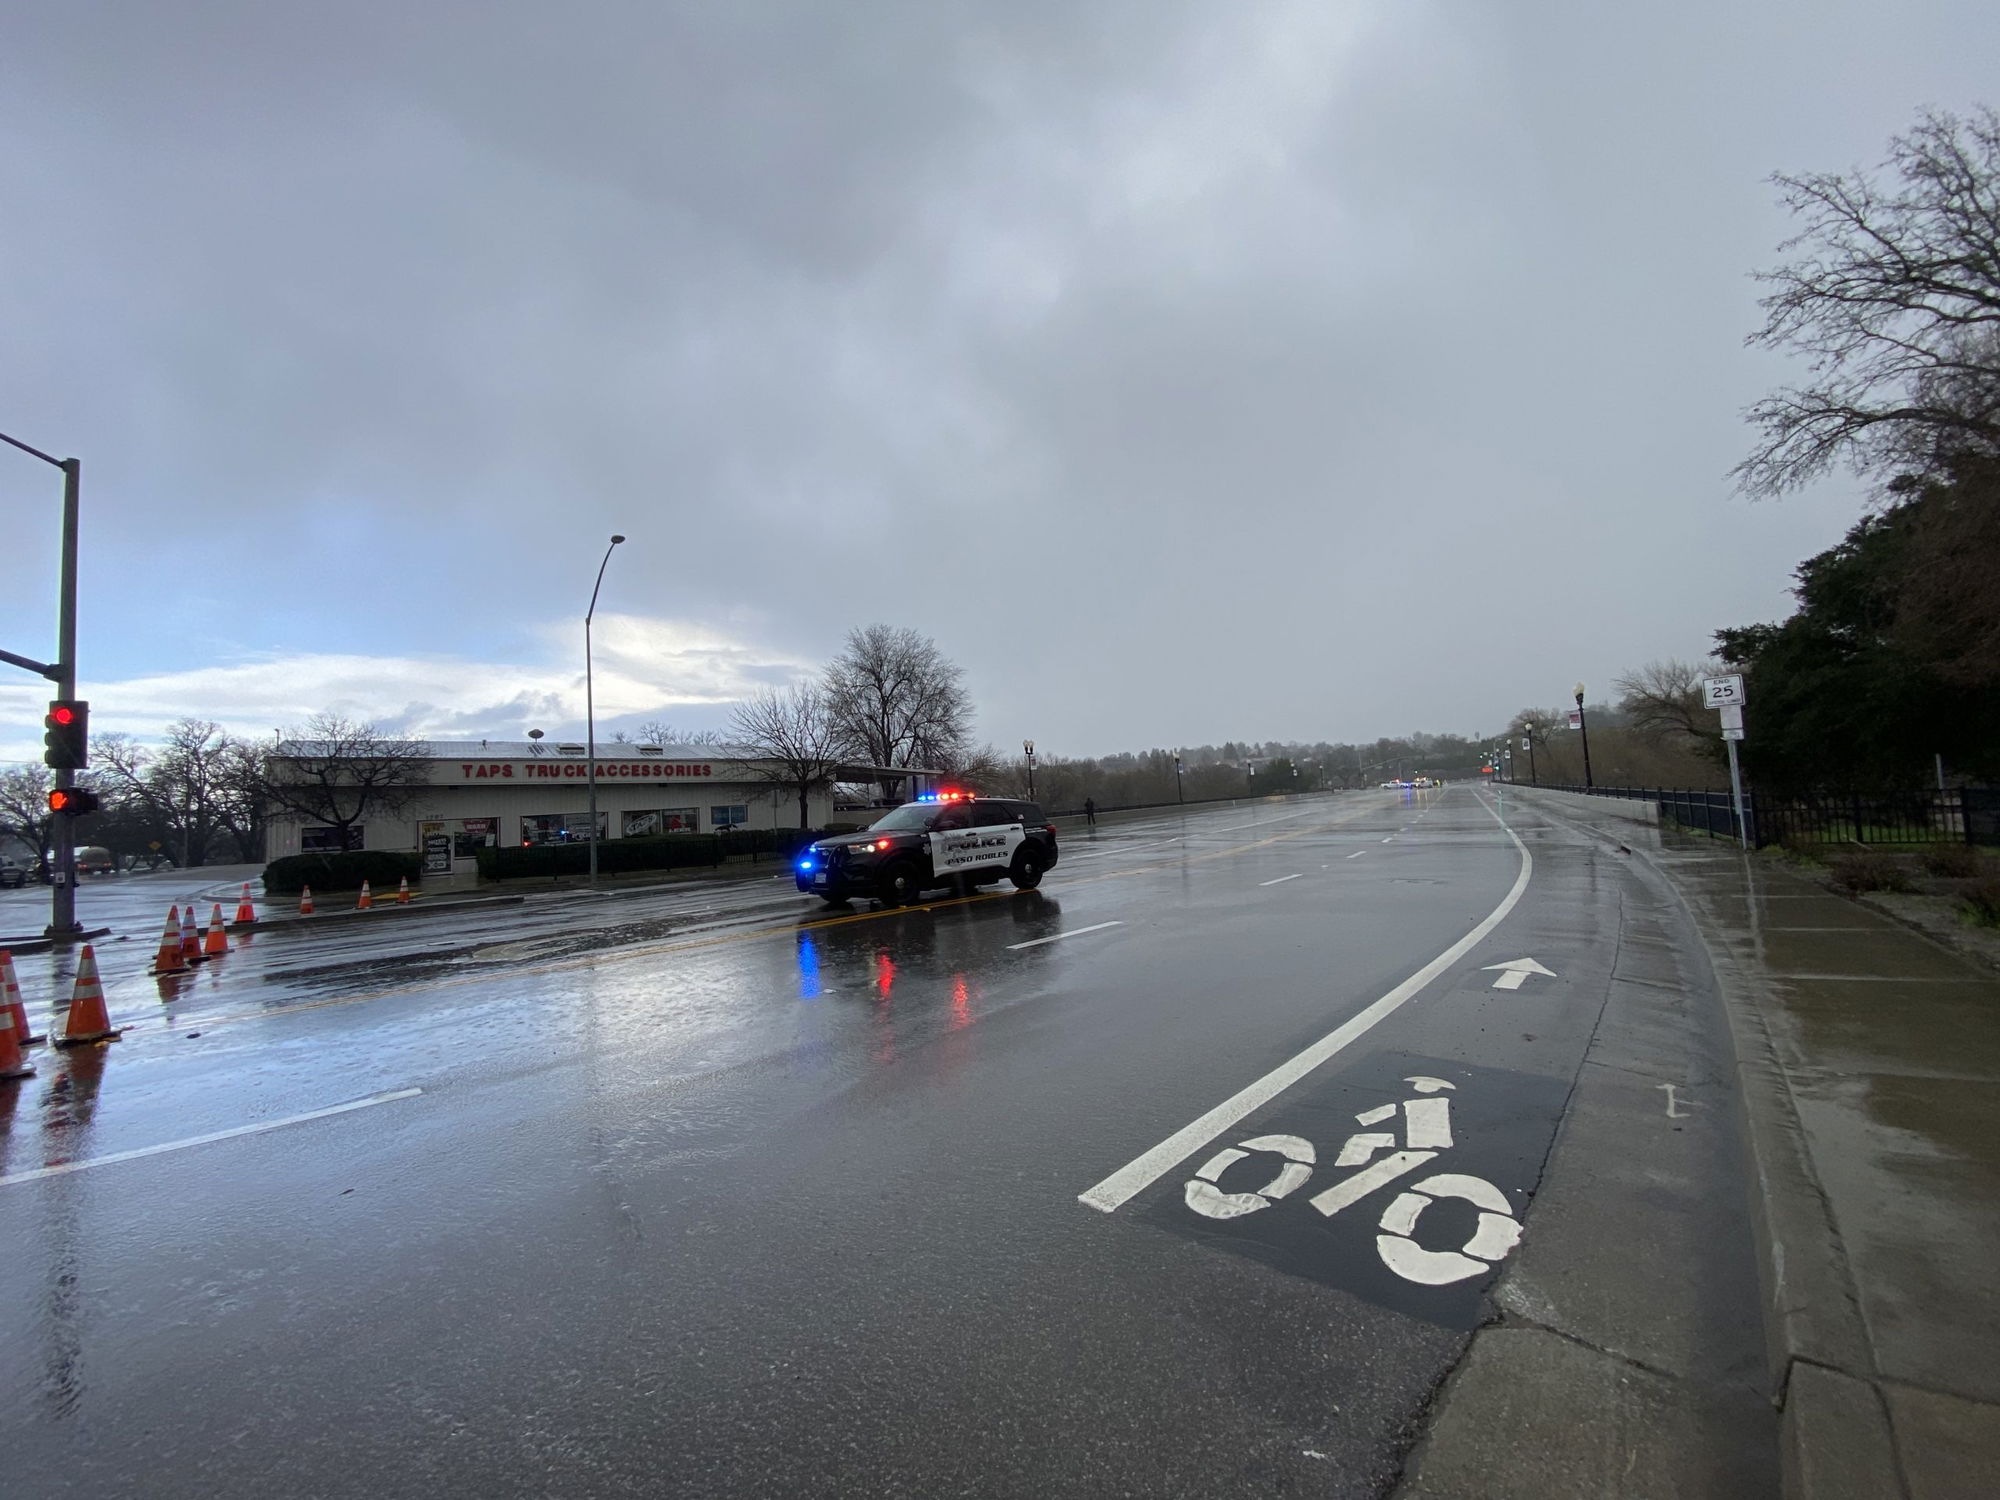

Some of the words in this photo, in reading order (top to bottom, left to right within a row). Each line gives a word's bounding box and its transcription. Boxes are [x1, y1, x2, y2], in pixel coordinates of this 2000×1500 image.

[1712, 685, 1734, 698] 25
[462, 764, 513, 778] TAPS
[525, 764, 588, 777] TRUCK
[595, 764, 711, 777] ACCESSORIES
[947, 836, 1006, 851] POLICE
[946, 856, 973, 865] PASO
[975, 851, 1009, 861] ROBLES
